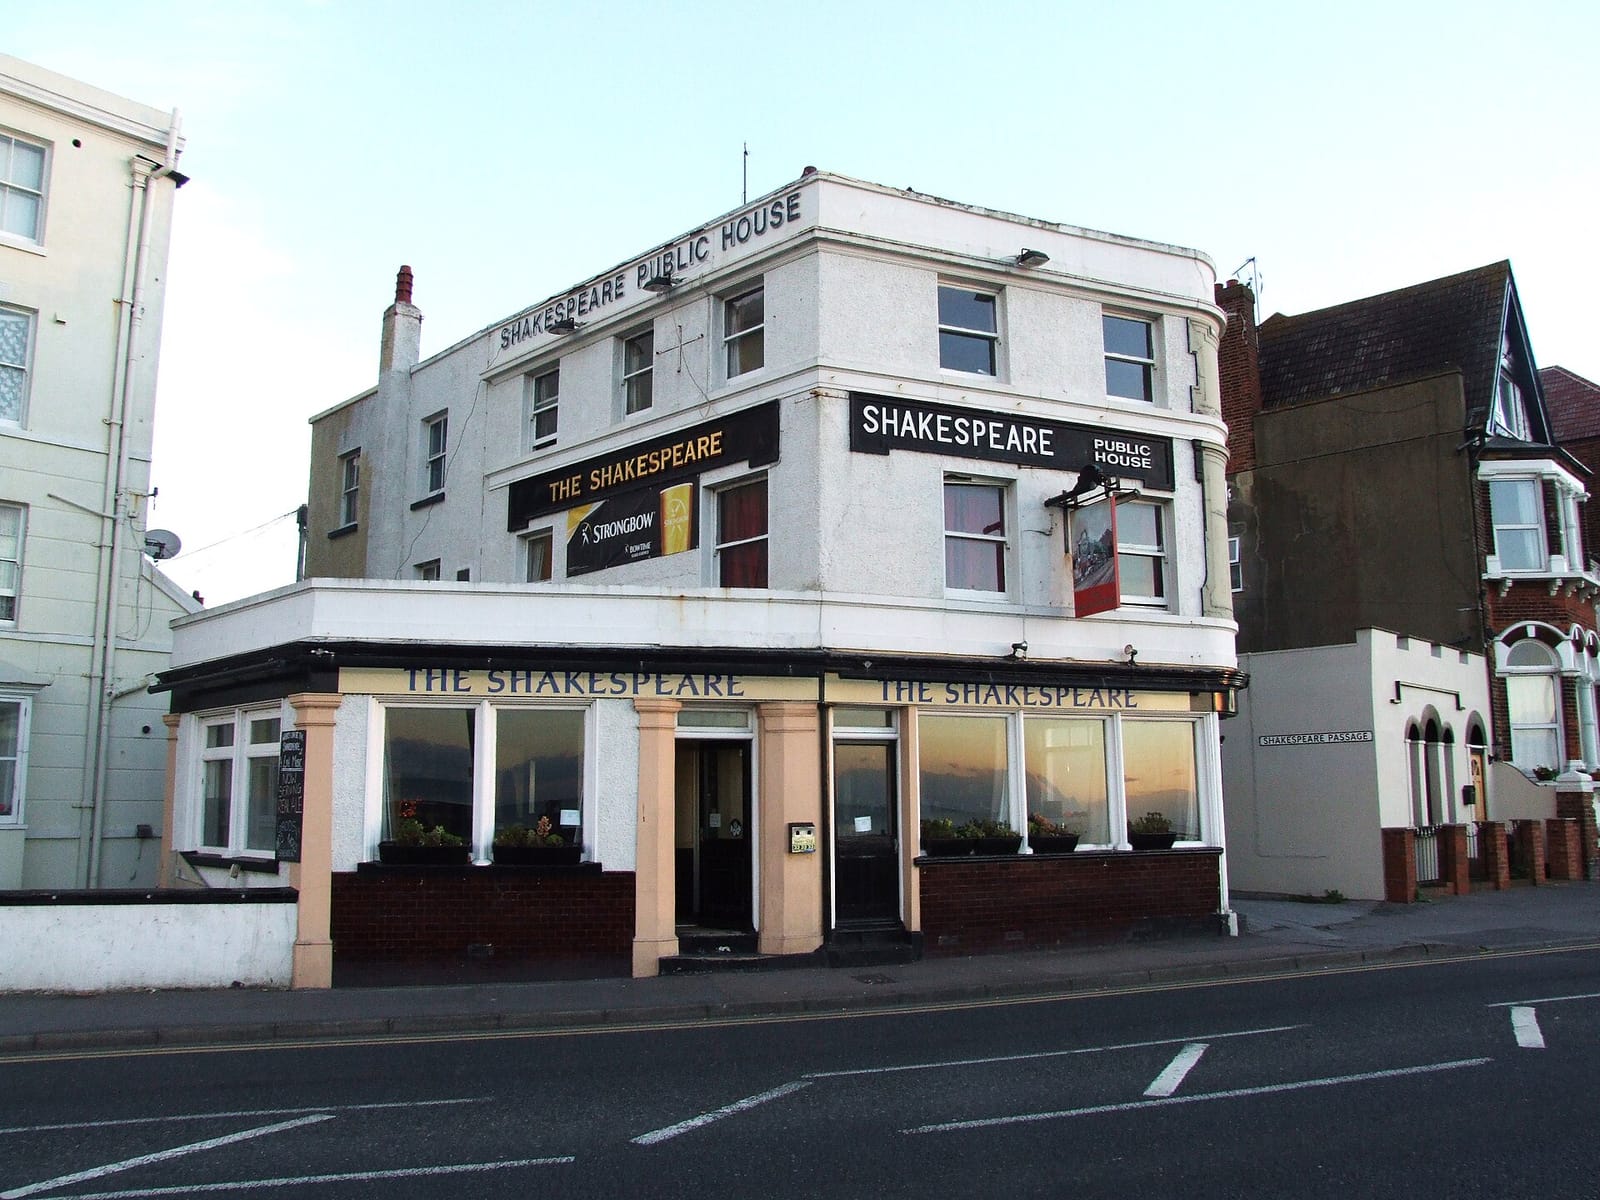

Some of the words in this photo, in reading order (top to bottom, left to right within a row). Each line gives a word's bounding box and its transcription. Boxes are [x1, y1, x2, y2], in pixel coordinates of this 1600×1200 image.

[501, 276, 624, 349] SHAKESPEARE
[637, 236, 710, 290] PUBLIC
[721, 193, 802, 250] HOUSE
[862, 405, 1054, 457] SHAKESPEARE
[1093, 438, 1151, 457] PUBLIC
[1094, 452, 1152, 469] HOUSE
[549, 475, 581, 502] THE
[590, 431, 723, 490] SHAKESPEARE
[593, 511, 653, 544] STRONGBOW
[404, 667, 472, 692] THE
[487, 669, 745, 697] SHAKESPEARE
[881, 680, 933, 703] THE
[945, 682, 1138, 707] SHAKESPEARE
[1263, 735, 1326, 745] SHAKESPEARE
[1328, 732, 1369, 742] PASSAGE
